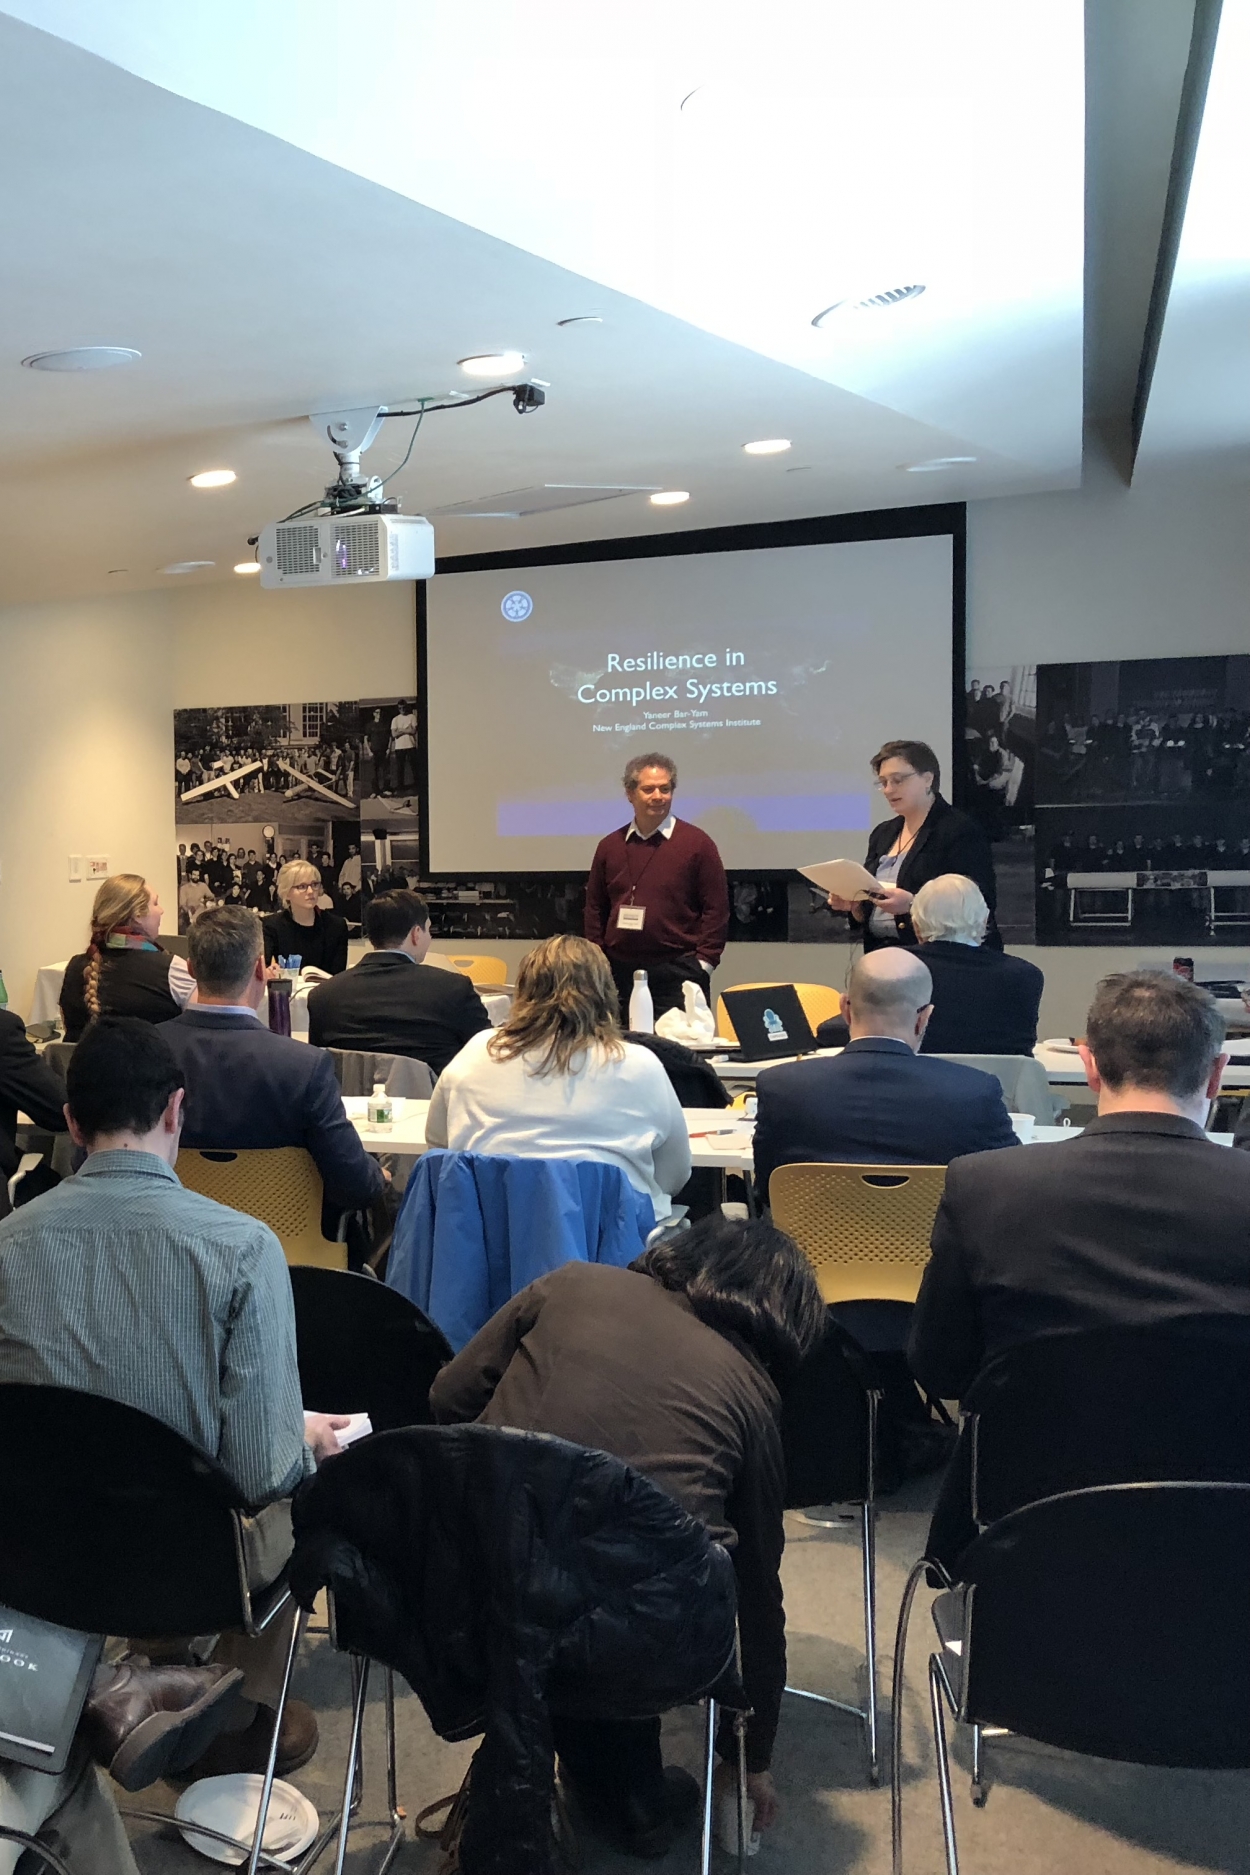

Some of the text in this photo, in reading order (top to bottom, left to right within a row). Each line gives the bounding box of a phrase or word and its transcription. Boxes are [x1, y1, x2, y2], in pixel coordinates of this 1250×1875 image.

[607, 648, 745, 672] Resilience in
[577, 679, 777, 706] Complex Systems
[643, 709, 708, 719] Yaneer Bar-Yam
[593, 718, 761, 732] New England Complex Systems Institute
